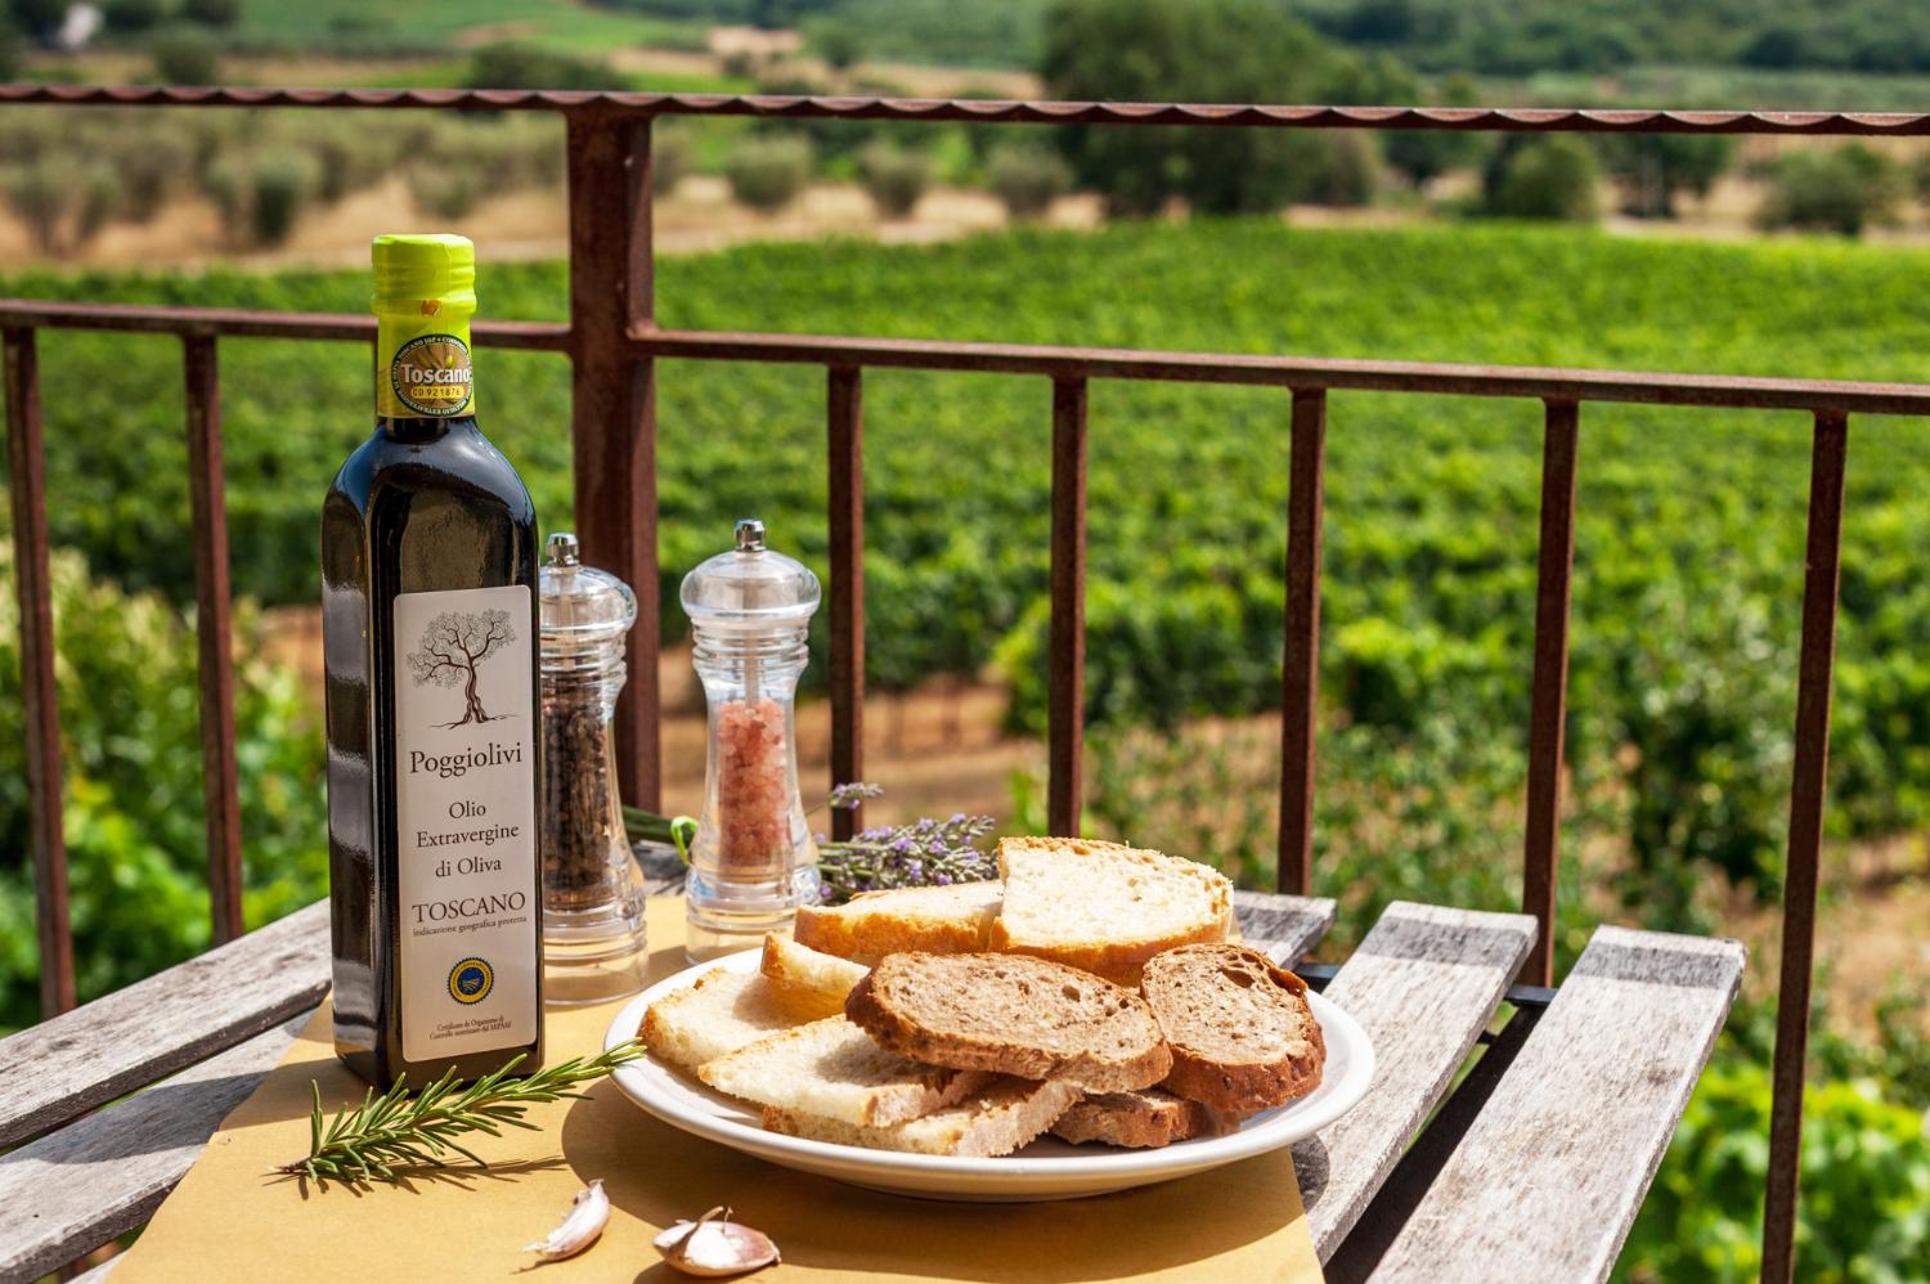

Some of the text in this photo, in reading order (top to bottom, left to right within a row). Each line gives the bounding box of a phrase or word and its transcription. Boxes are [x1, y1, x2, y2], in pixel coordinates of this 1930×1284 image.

[401, 363, 471, 384] Toscano
[410, 742, 522, 778] Poggiolivi
[449, 800, 486, 819] Olio
[417, 824, 520, 848] Extravergine
[435, 856, 502, 877] di Oliva
[412, 892, 526, 923] TOSCANO
